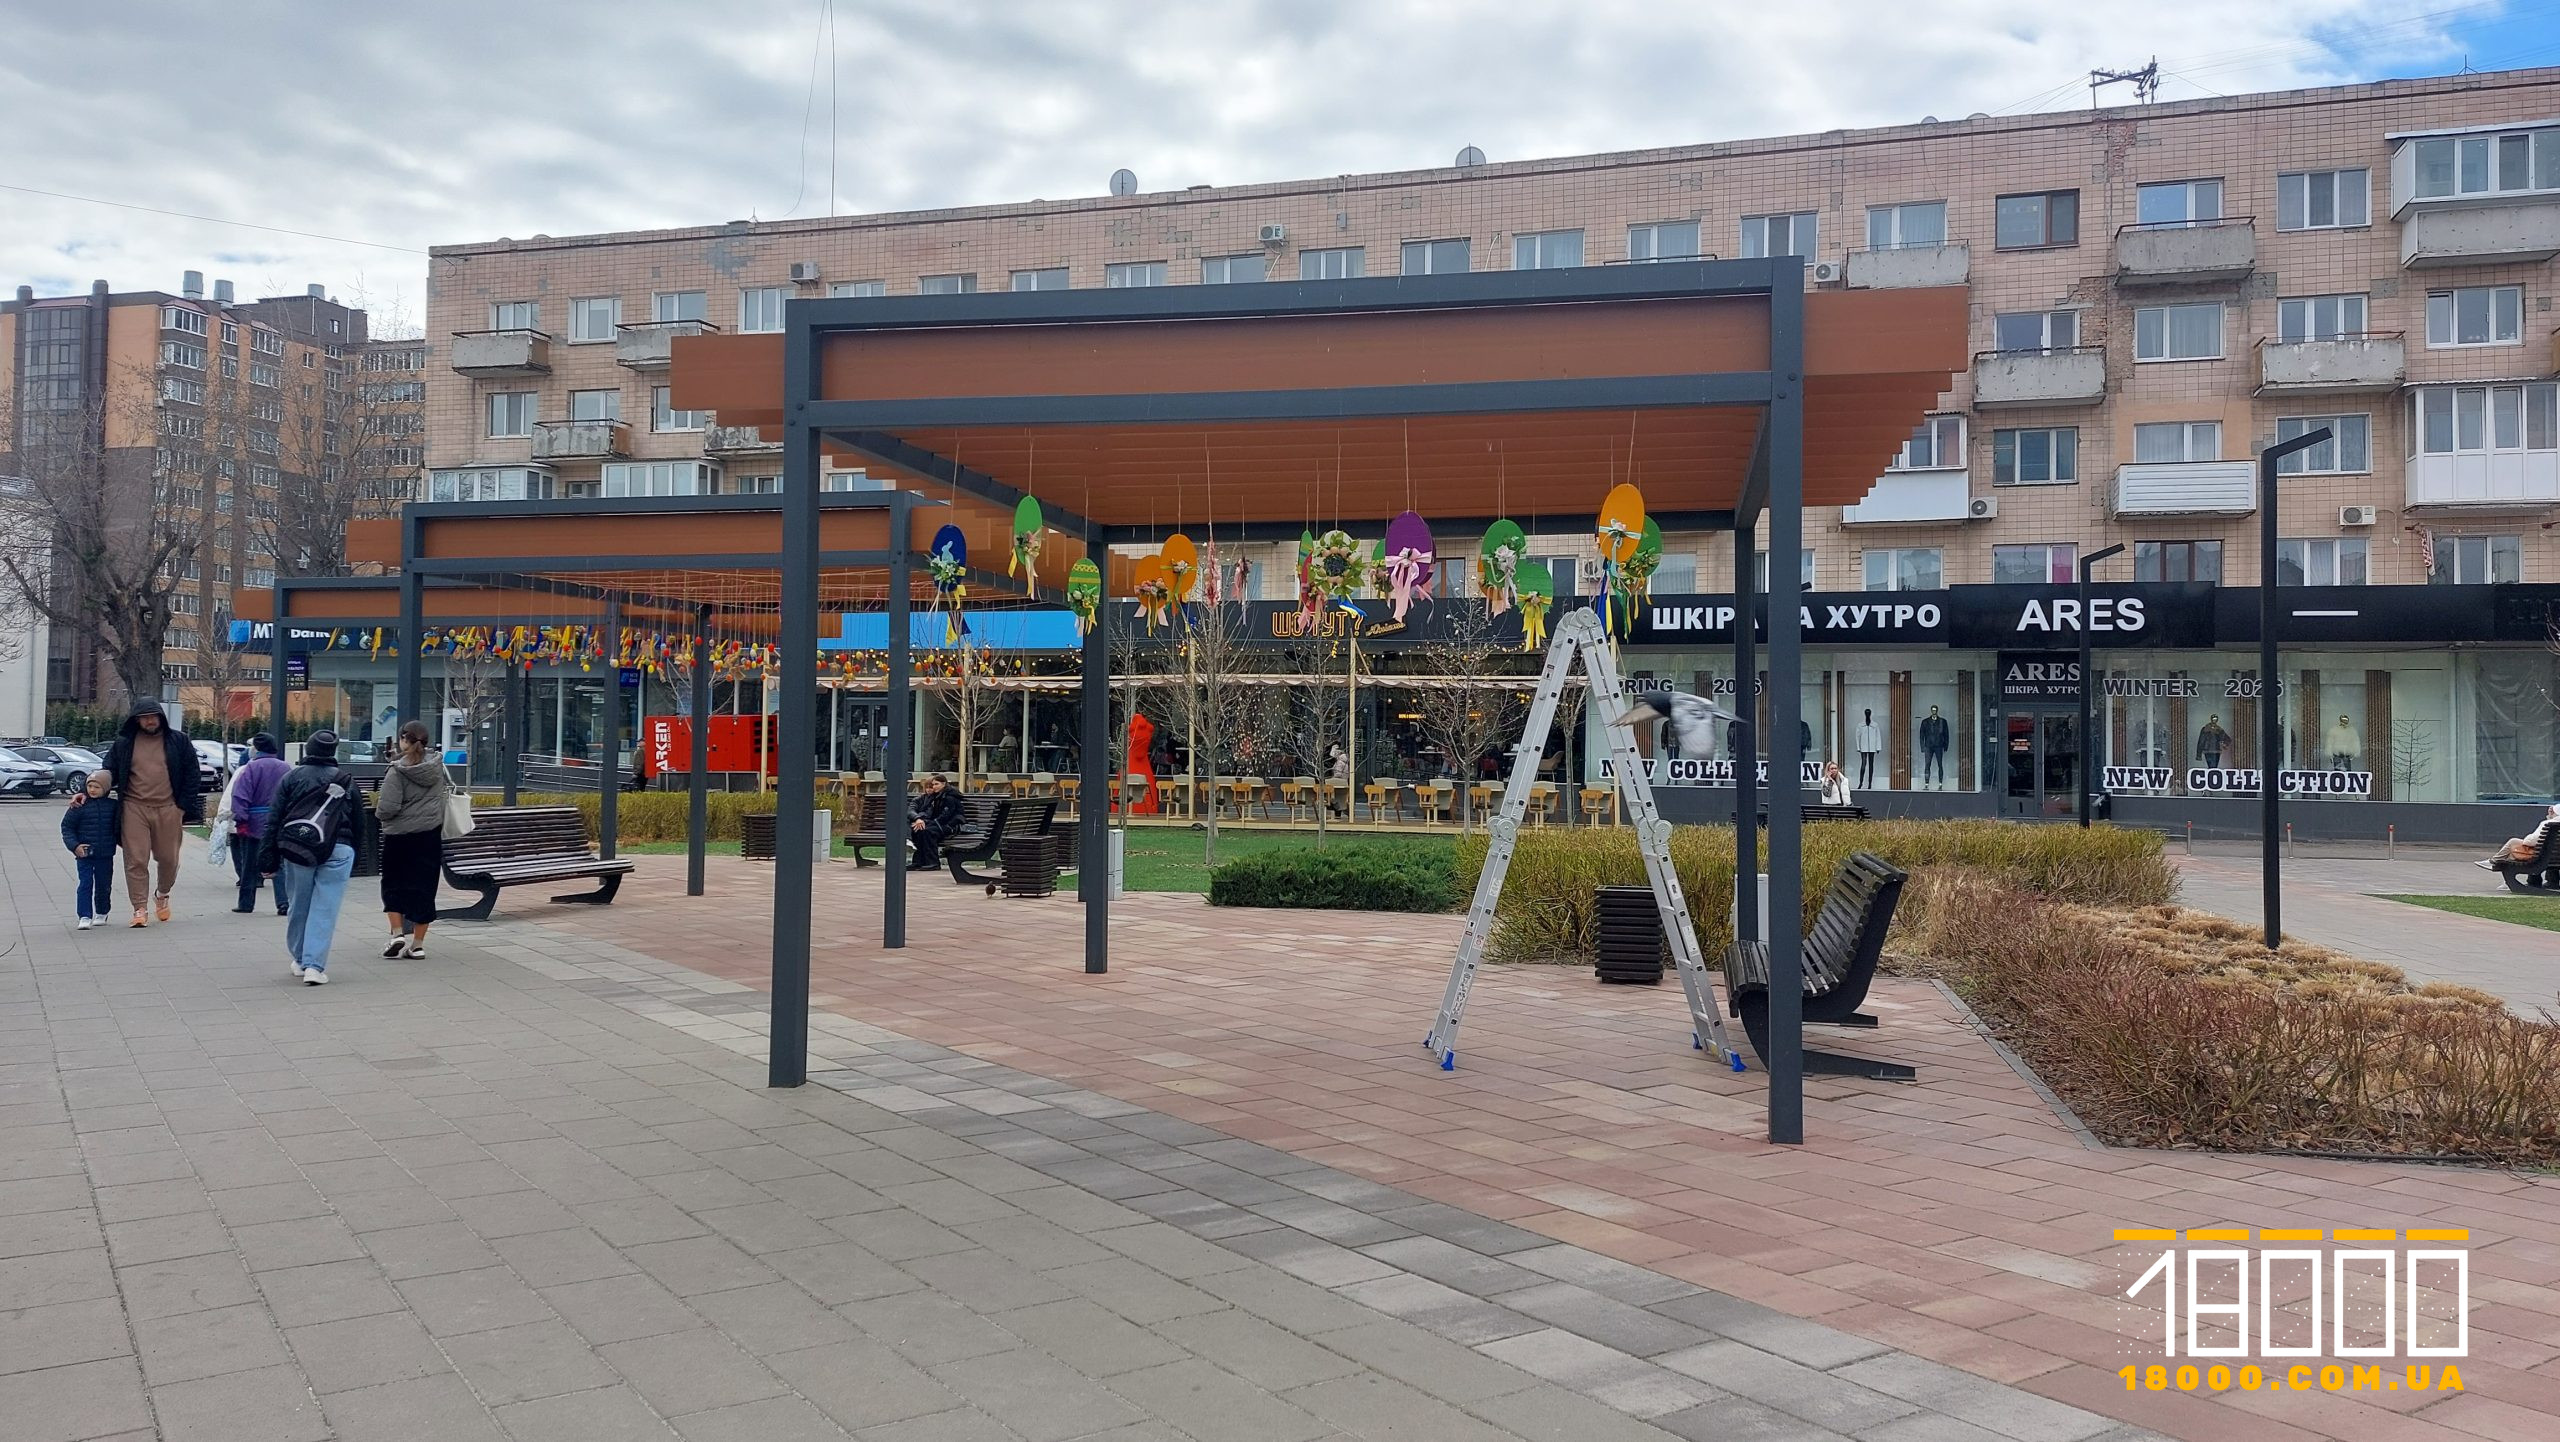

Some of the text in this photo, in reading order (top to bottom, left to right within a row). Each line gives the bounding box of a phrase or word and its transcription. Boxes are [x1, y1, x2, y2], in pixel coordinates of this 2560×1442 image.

[1652, 606, 1759, 630] ШКІР
[1825, 604, 1941, 629] ХУТРО
[2016, 598, 2145, 631] ARES
[2005, 663, 2081, 681] ARES
[1618, 677, 1763, 696] RING 206
[2004, 685, 2040, 694] ШКІРА
[2103, 678, 2199, 697] WINTER
[655, 722, 668, 771] ARKEN
[2103, 766, 2373, 795] NEW COLLCTION
